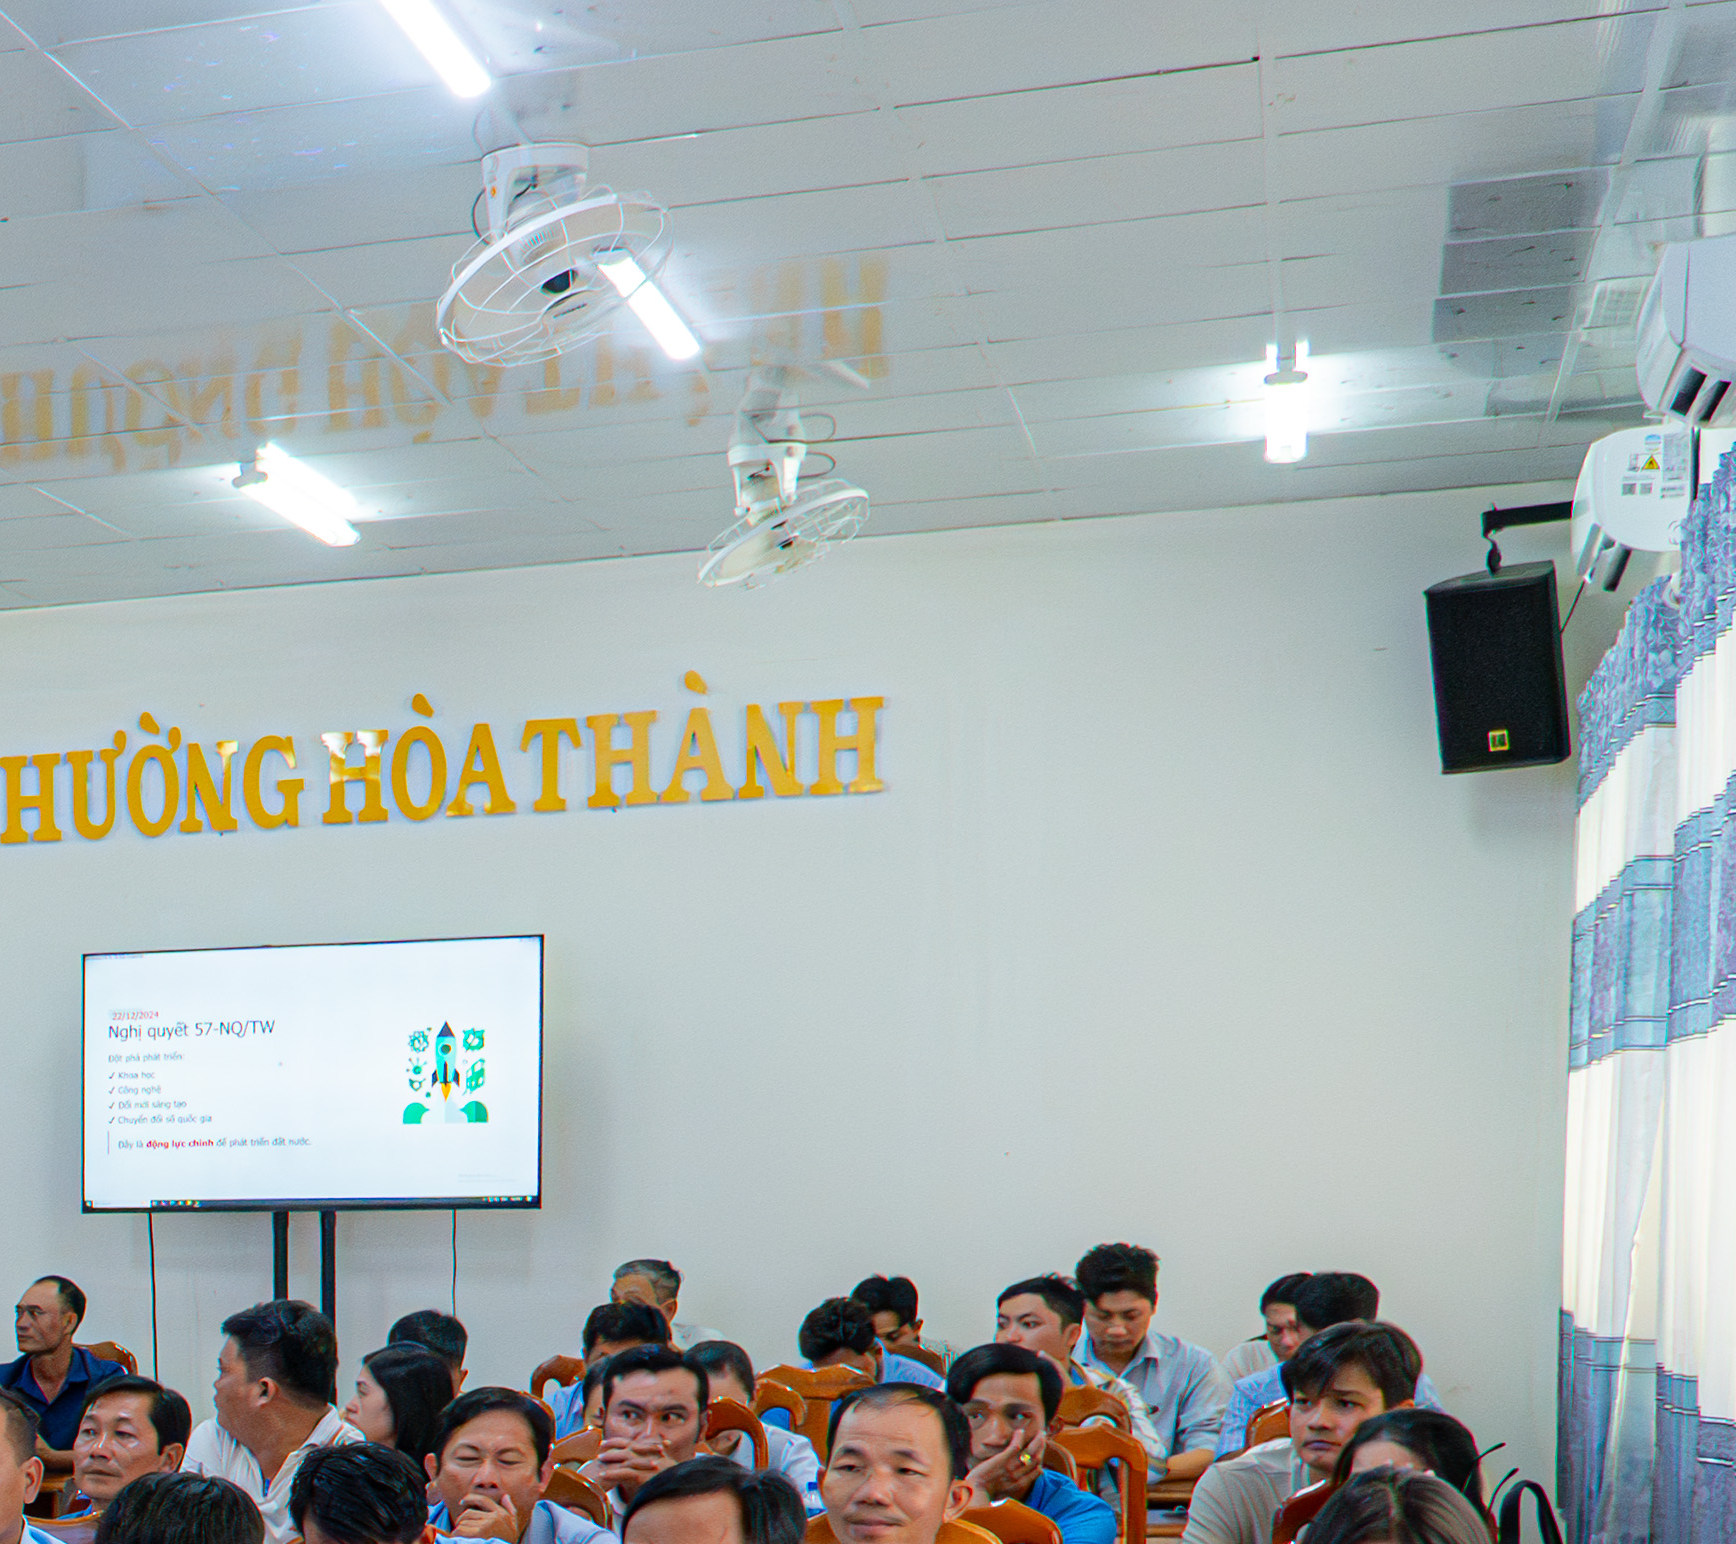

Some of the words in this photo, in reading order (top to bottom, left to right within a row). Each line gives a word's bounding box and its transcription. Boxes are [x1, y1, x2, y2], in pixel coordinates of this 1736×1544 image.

[320, 693, 517, 823] HÒA
[520, 670, 885, 812] THÀNH
[112, 1010, 160, 1021] 22/12/2024
[108, 1024, 142, 1042] Nghị
[147, 1021, 189, 1041] quyết
[194, 1019, 276, 1038] 57-NQ/TW
[118, 1071, 139, 1079] Khoa
[146, 1139, 170, 1150] động
